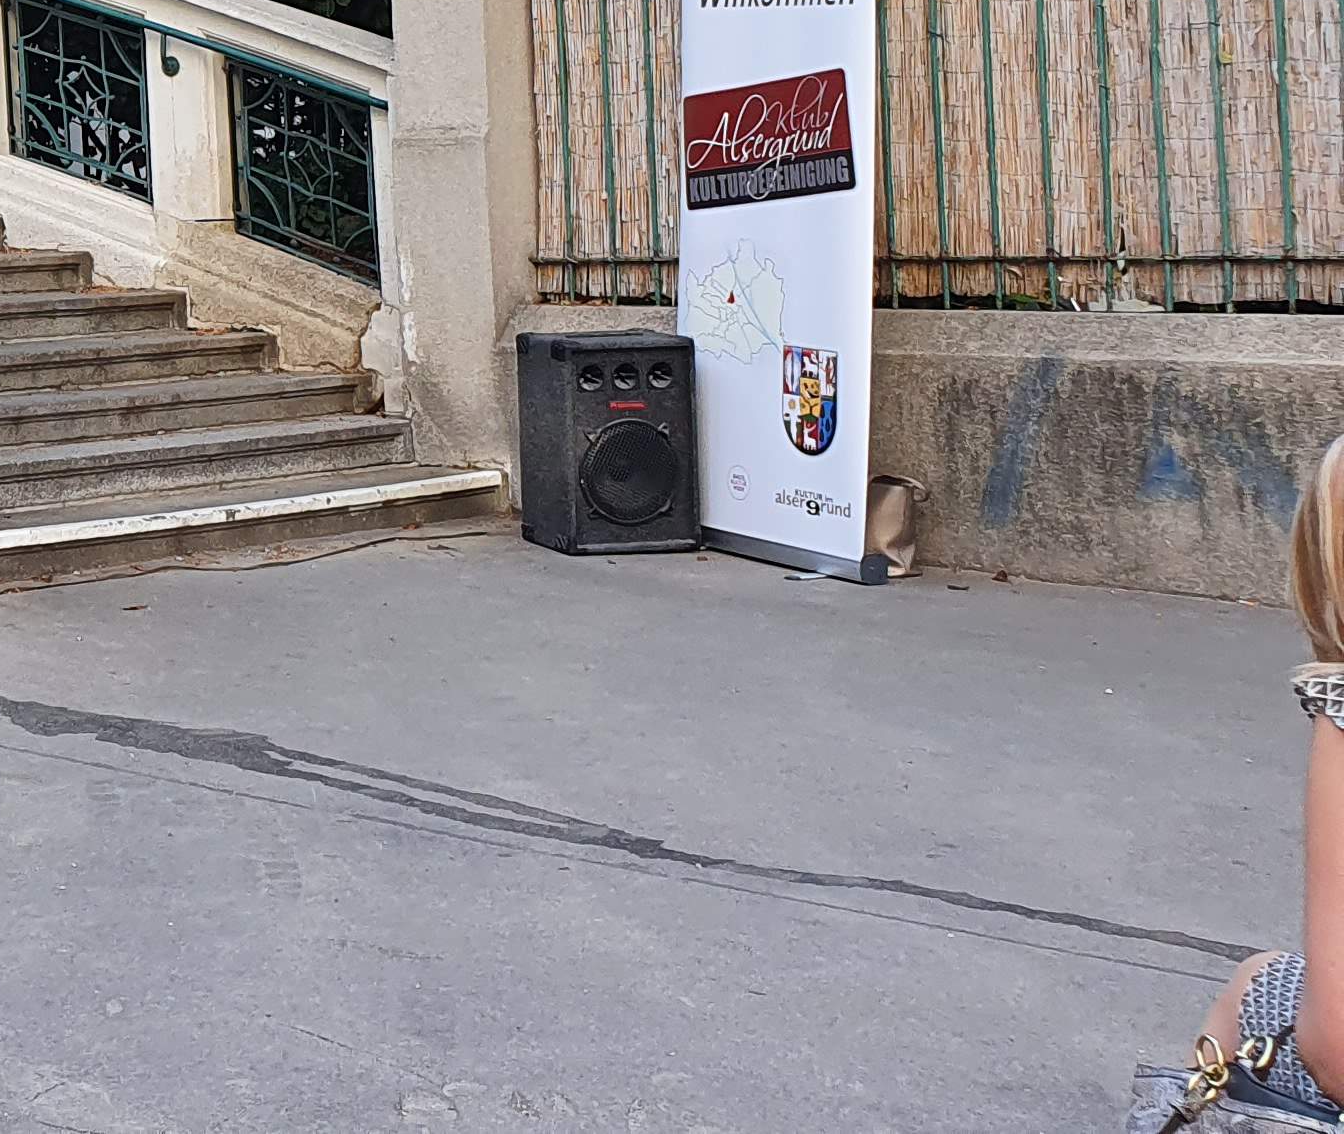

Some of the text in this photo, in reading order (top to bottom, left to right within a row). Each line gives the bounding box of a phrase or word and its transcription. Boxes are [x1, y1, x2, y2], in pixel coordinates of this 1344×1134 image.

[765, 75, 829, 135] Klub
[686, 92, 844, 200] Alsergrund
[689, 155, 850, 203] KULTURVEREINIGUNG
